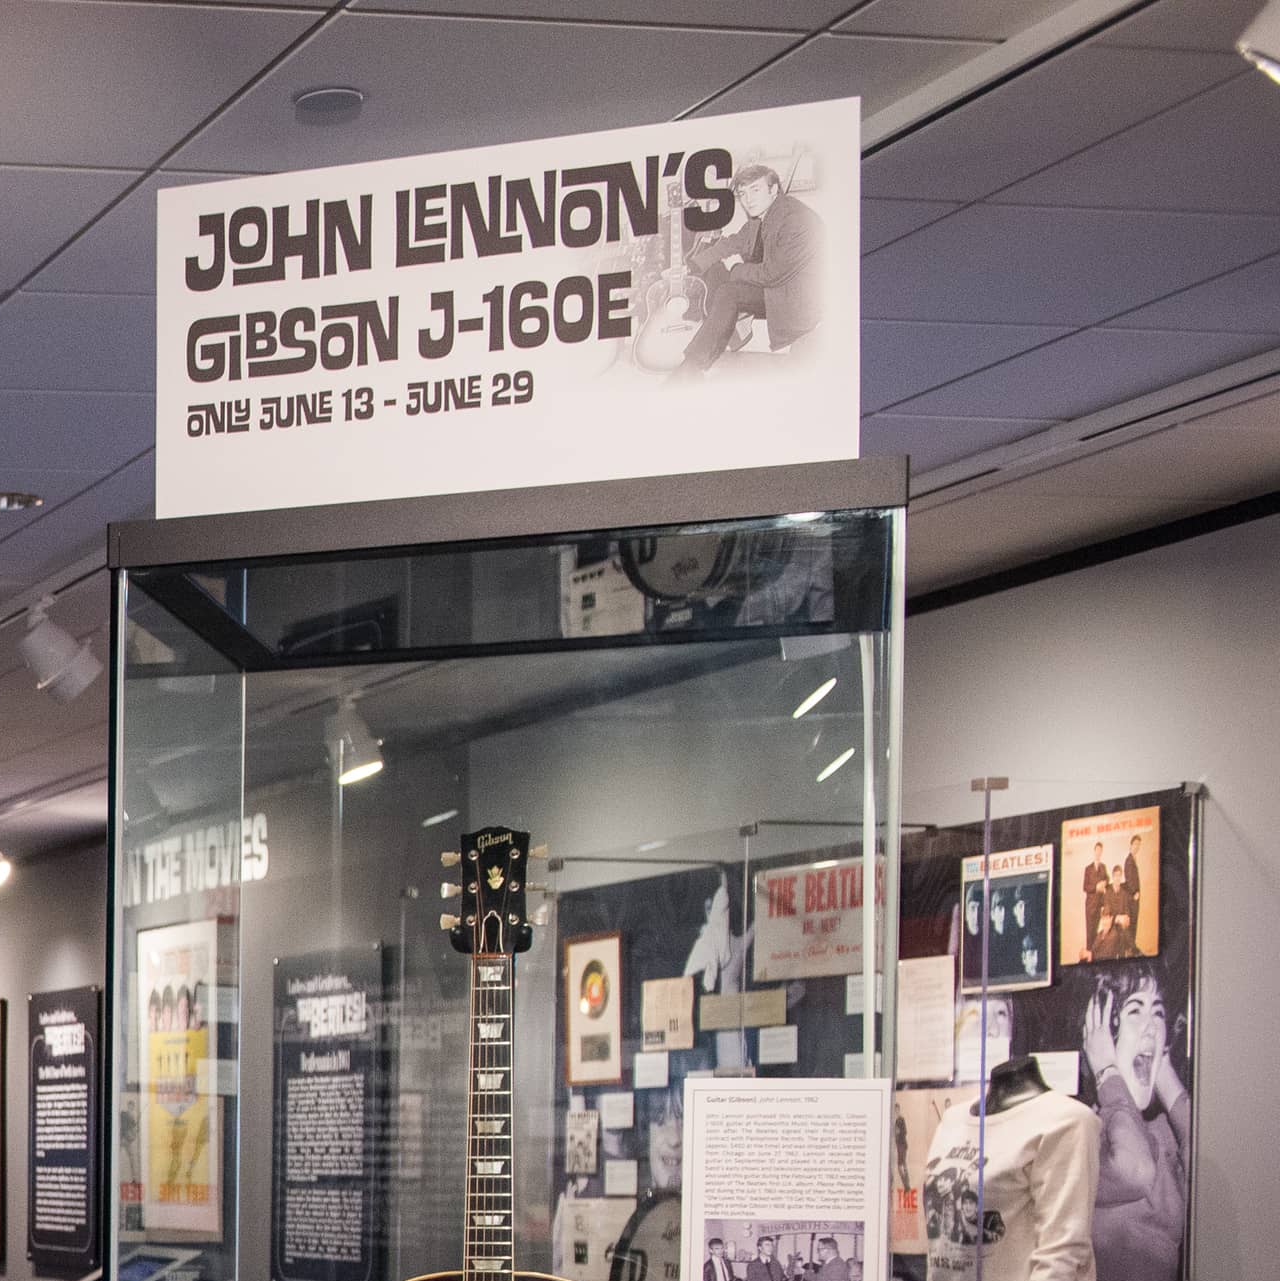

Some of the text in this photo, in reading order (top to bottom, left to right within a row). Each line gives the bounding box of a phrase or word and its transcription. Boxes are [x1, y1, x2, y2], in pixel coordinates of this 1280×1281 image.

[184, 147, 735, 292] JOHN LENNON'S
[185, 271, 632, 383] GIBSON J-160E
[187, 397, 251, 437] ONLY
[258, 390, 333, 430] JUNE
[342, 386, 374, 421] 13
[405, 374, 482, 415] JUNE
[491, 370, 535, 405] 29
[476, 831, 513, 850] Gibson
[1068, 817, 1153, 839] THE BEATLES
[767, 863, 886, 918] THE BEATLS
[896, 1188, 918, 1210] THE
[663, 1262, 680, 1279] TH
